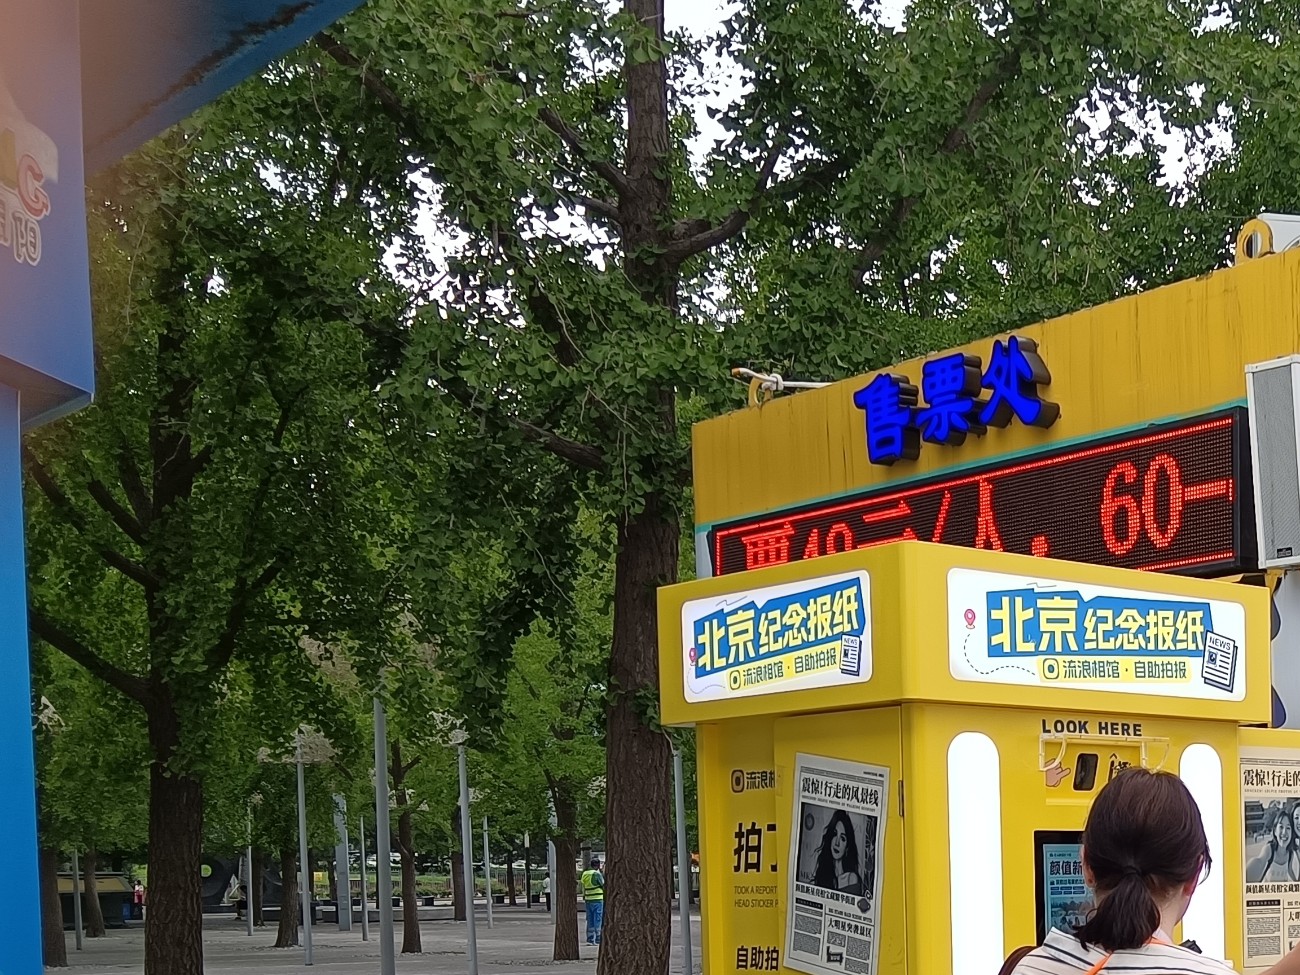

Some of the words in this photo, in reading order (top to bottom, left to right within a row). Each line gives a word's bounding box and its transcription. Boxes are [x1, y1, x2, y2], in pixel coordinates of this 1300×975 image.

[853, 334, 1042, 465] 售票处
[697, 584, 860, 673] 北京纪念报纸
[990, 595, 1206, 653] 北京纪念报纸
[843, 635, 858, 646] NEWS
[1208, 634, 1232, 652] NEWS
[1041, 718, 1090, 735] LOOK
[1098, 721, 1143, 737] HERE
[1050, 860, 1082, 876] 颜值新
[734, 885, 750, 895] TOOK
[755, 886, 777, 895] REPORT
[734, 898, 750, 908] HEAD
[750, 898, 774, 908] STICKER
[736, 945, 779, 971] 自助拍
